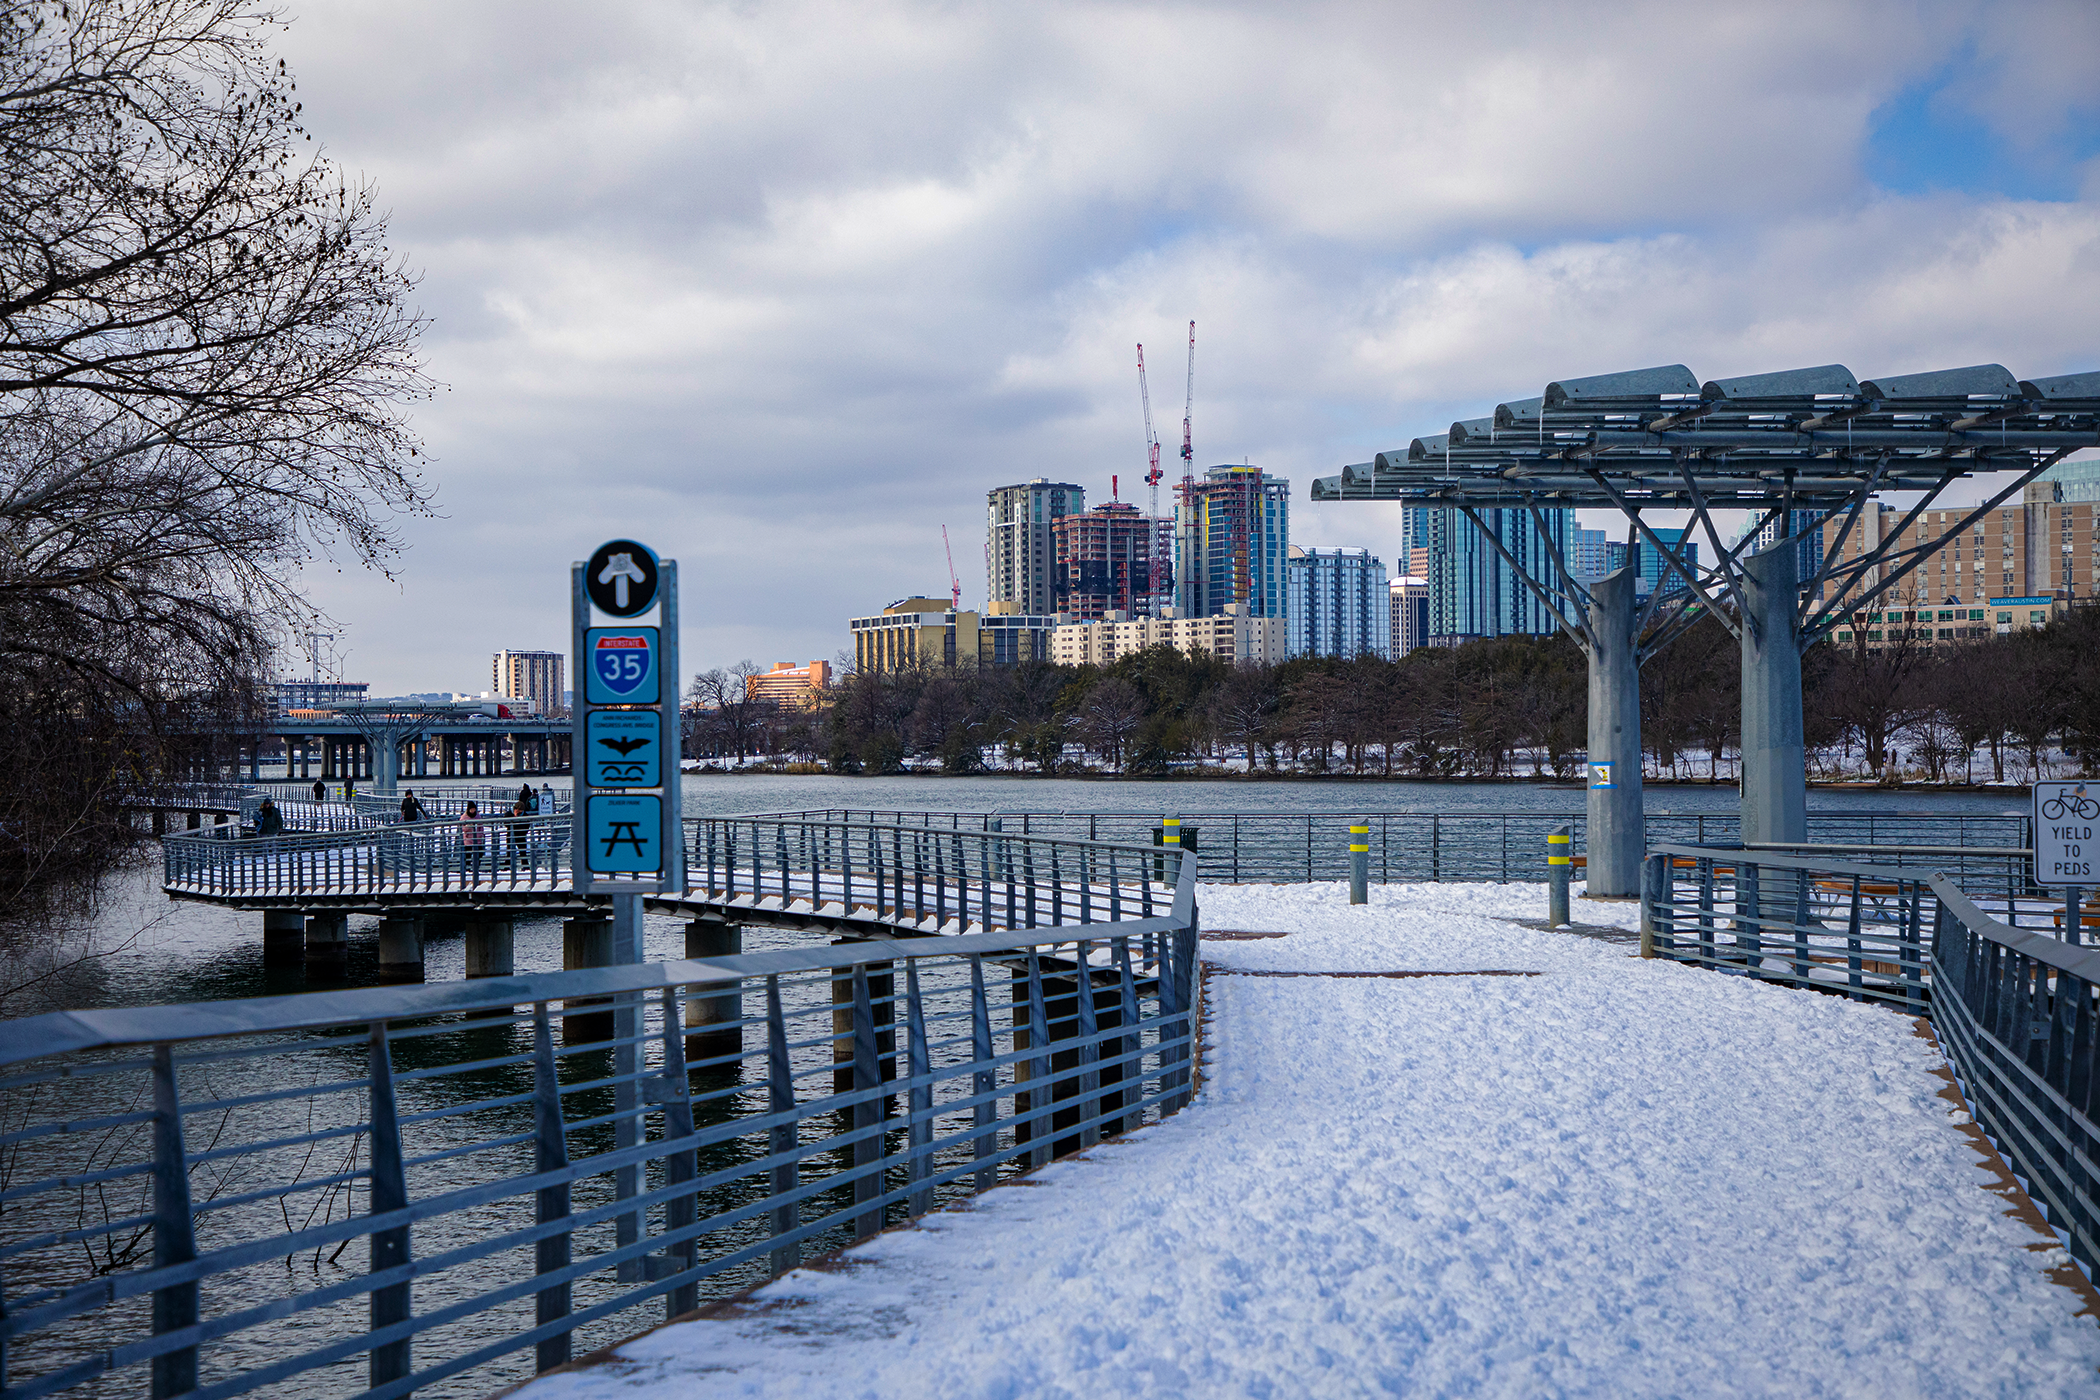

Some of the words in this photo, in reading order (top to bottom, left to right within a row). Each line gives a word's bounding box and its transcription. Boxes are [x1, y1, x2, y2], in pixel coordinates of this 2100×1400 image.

[603, 639, 640, 647] INTERSTATE
[604, 654, 641, 680] 35
[2051, 826, 2092, 840] YIELD
[2063, 844, 2081, 858] TO
[2054, 862, 2091, 876] PEDS
